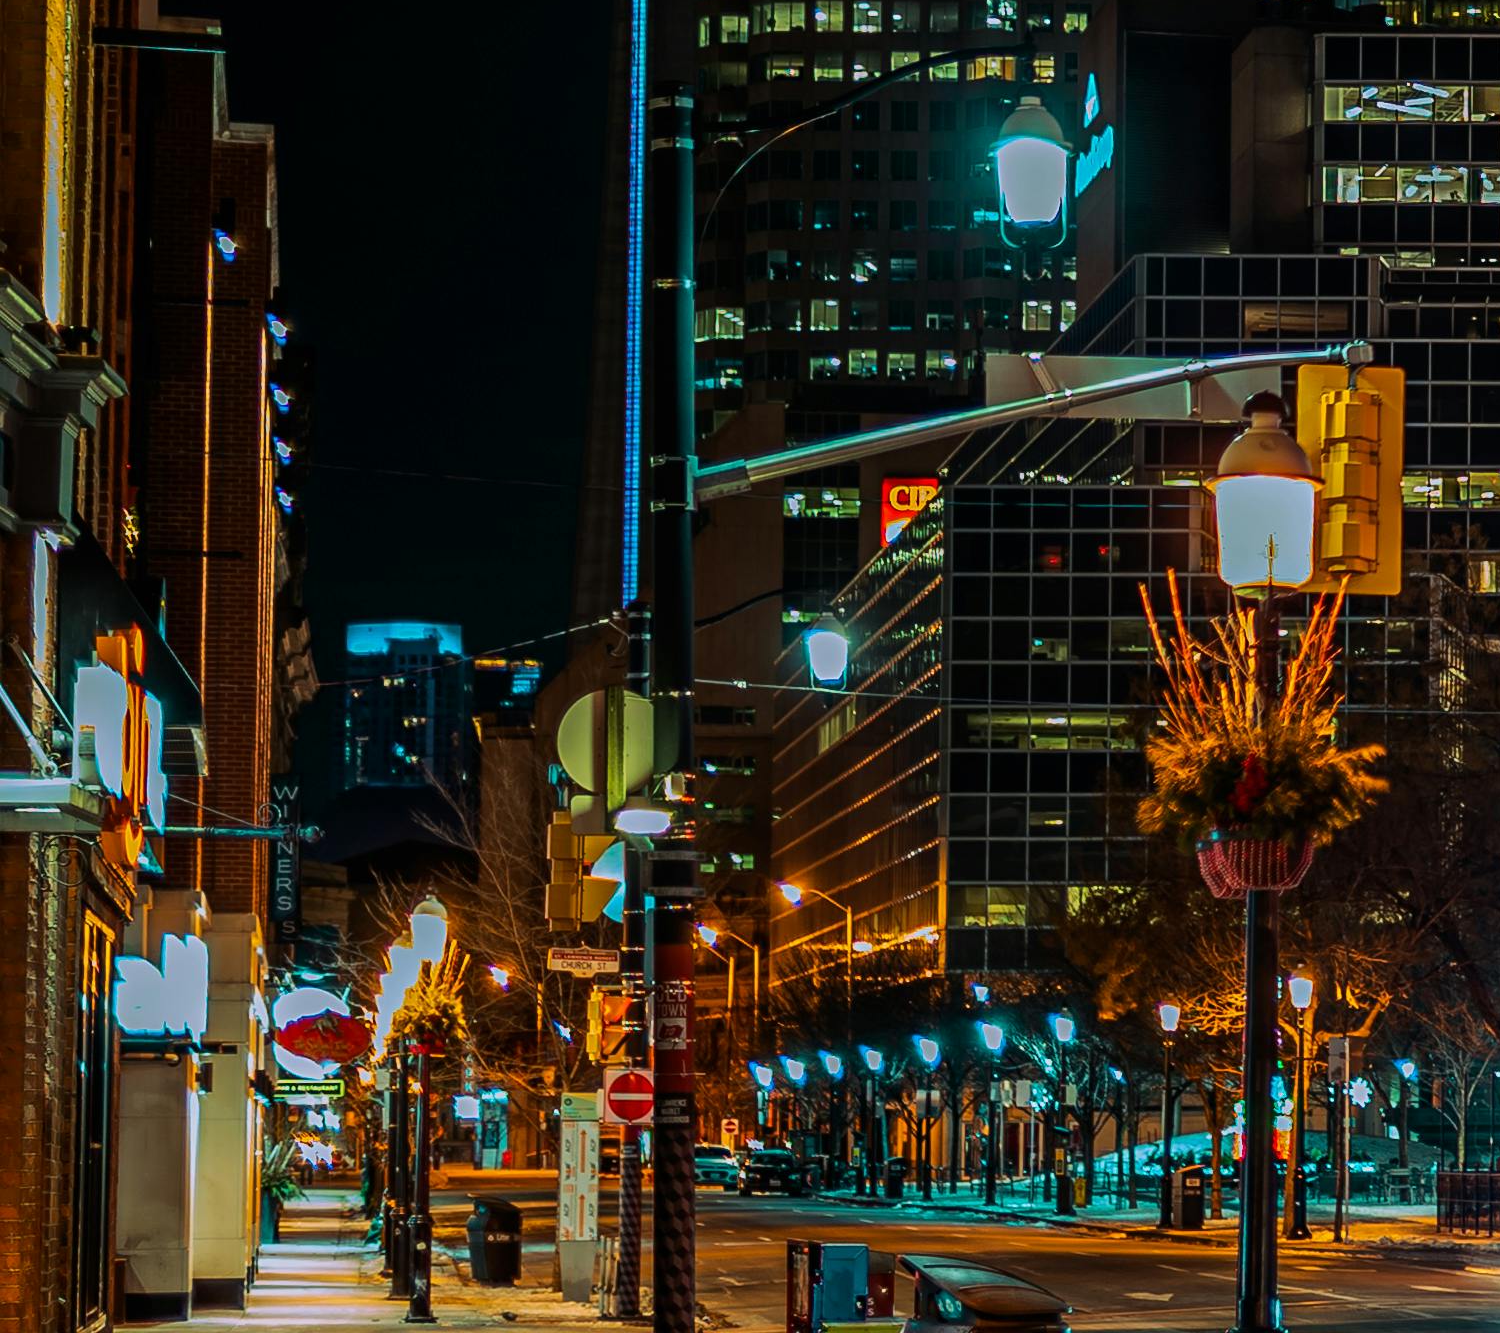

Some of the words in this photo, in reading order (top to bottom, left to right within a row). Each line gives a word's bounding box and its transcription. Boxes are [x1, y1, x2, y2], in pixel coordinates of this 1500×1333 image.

[273, 785, 299, 911] WINERS
[560, 961, 592, 970] CHURCH
[597, 962, 607, 971] ST
[655, 984, 688, 1003] OLD
[656, 1003, 688, 1017] TOWN
